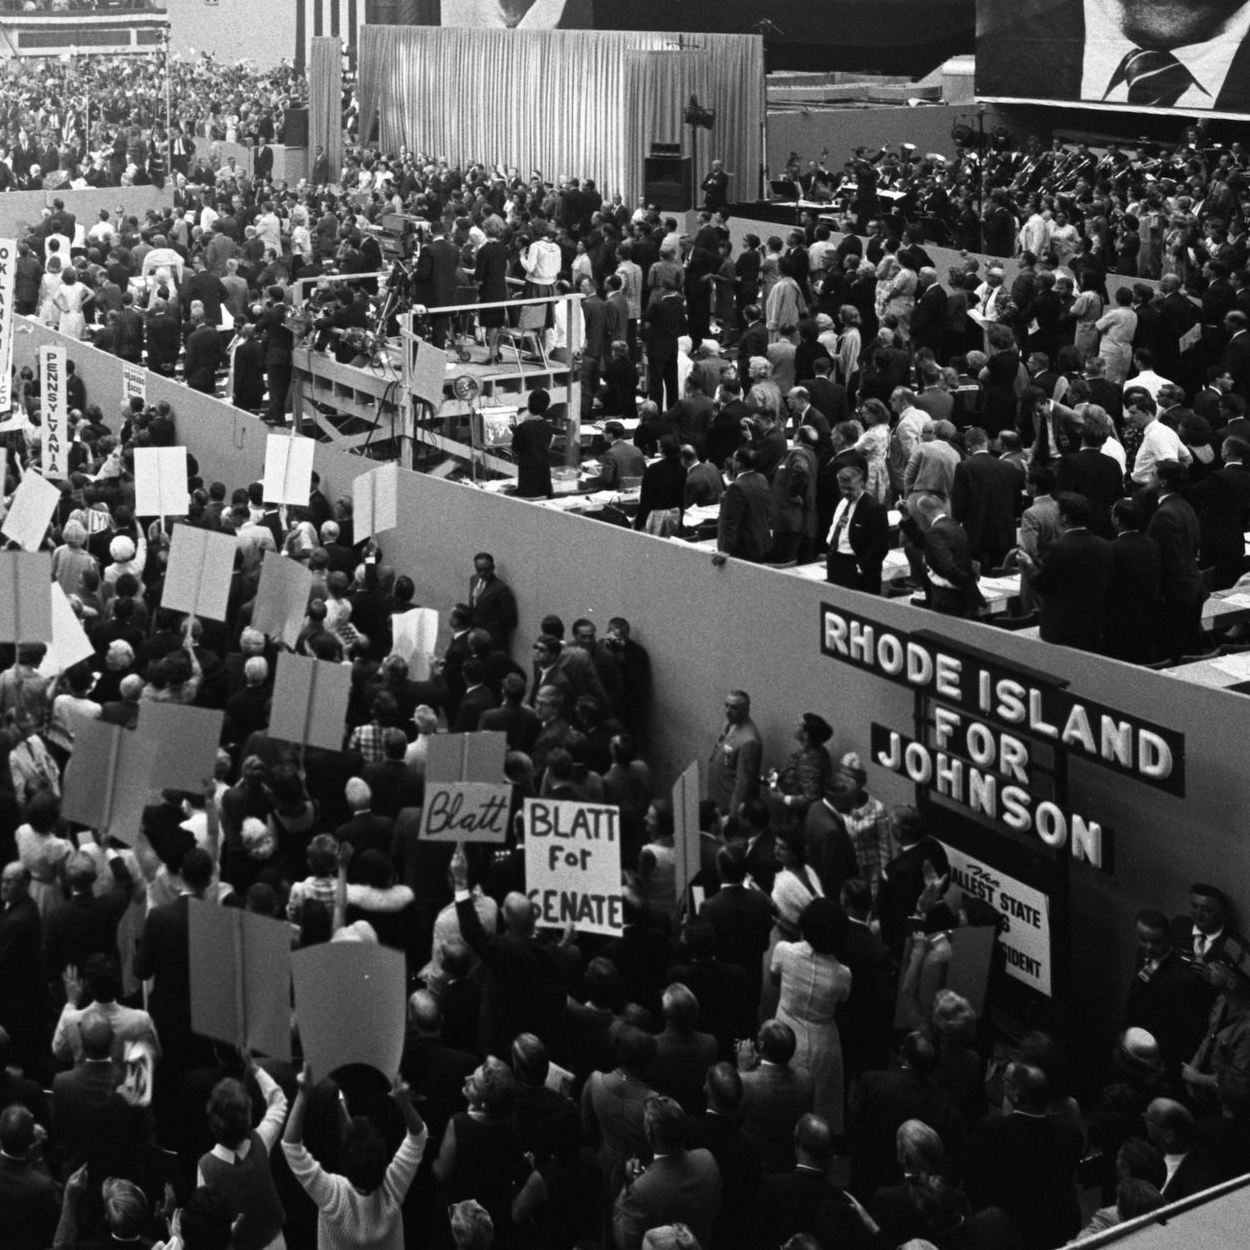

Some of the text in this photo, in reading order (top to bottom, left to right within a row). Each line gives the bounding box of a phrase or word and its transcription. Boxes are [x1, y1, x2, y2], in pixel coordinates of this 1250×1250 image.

[46, 352, 60, 474] PENNSYLVANIA
[824, 611, 1173, 780] RHODE ISLAND
[935, 706, 1030, 785] FOR
[425, 790, 508, 836] Blatt
[530, 802, 619, 842] BLATT
[877, 732, 1102, 869] JOHNSON
[548, 845, 592, 871] For
[966, 863, 1000, 888] The
[527, 888, 623, 929] SENATE
[951, 867, 1042, 930] ALLEST STATE
[1001, 941, 1042, 979] SIDENT
